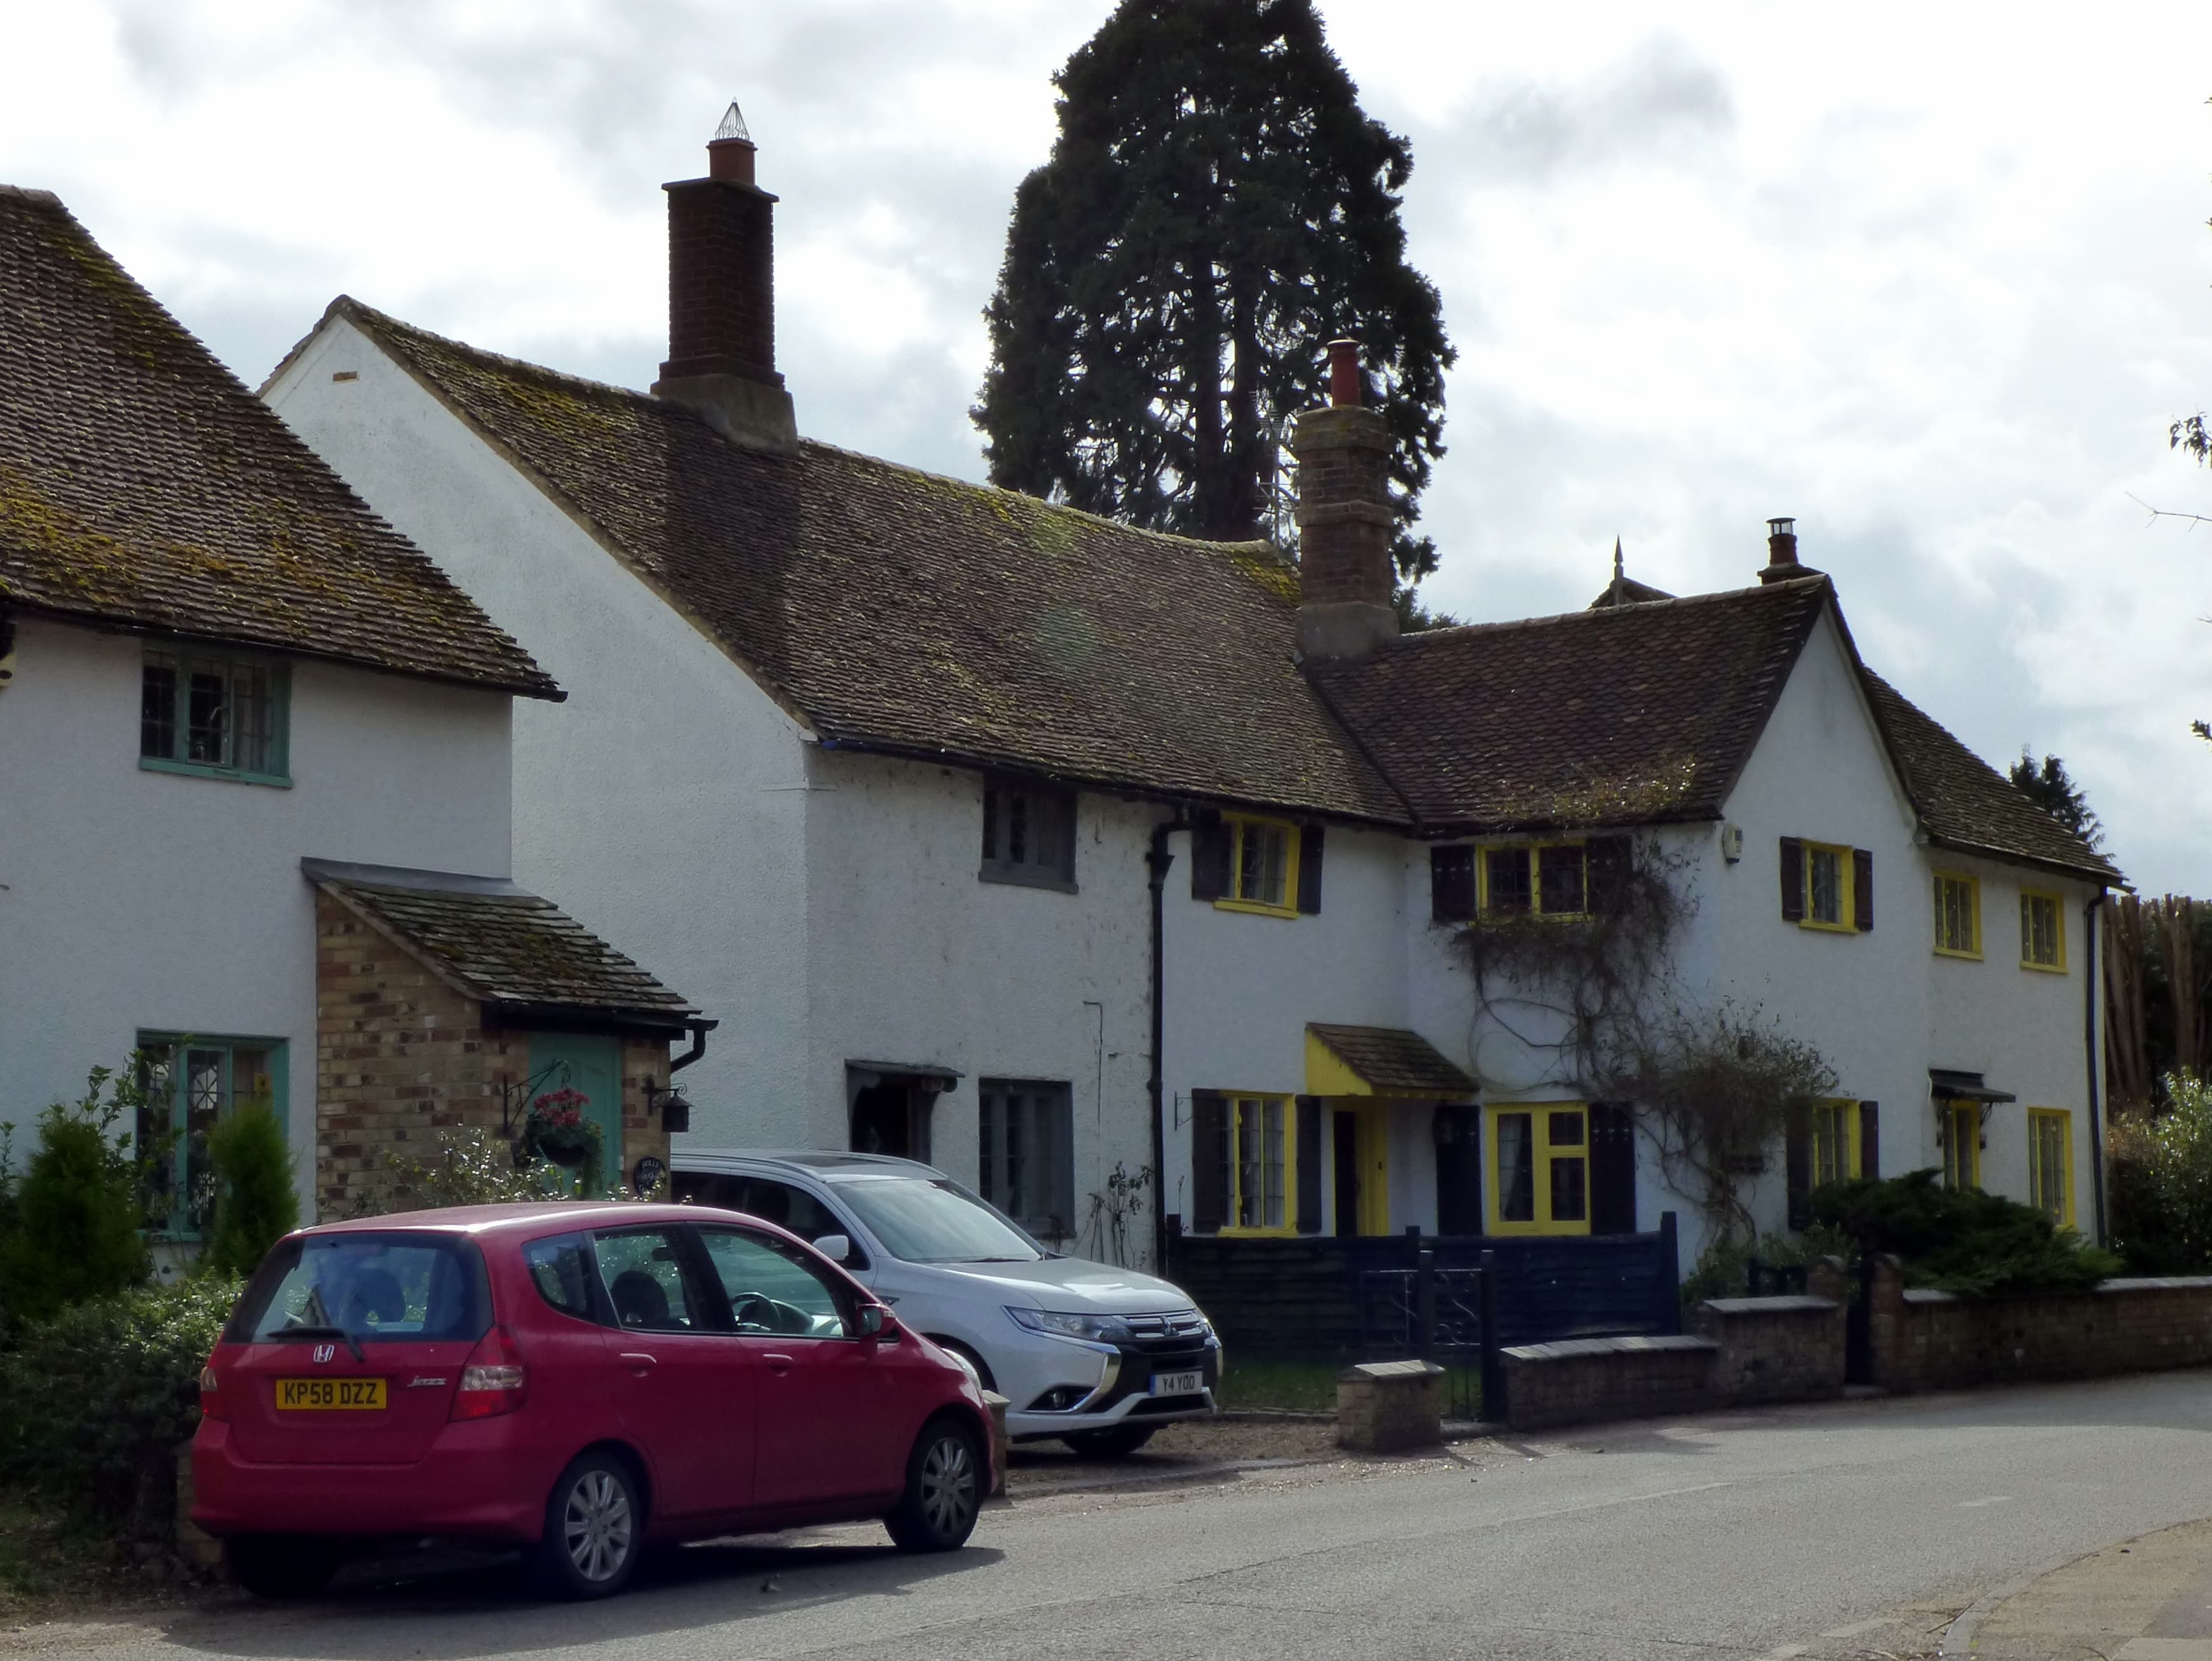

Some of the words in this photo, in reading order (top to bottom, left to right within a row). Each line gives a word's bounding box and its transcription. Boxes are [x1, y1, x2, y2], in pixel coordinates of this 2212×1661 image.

[284, 1382, 333, 1405] KP58
[340, 1382, 378, 1404] DZZ
[1162, 1376, 1174, 1392] Y4
